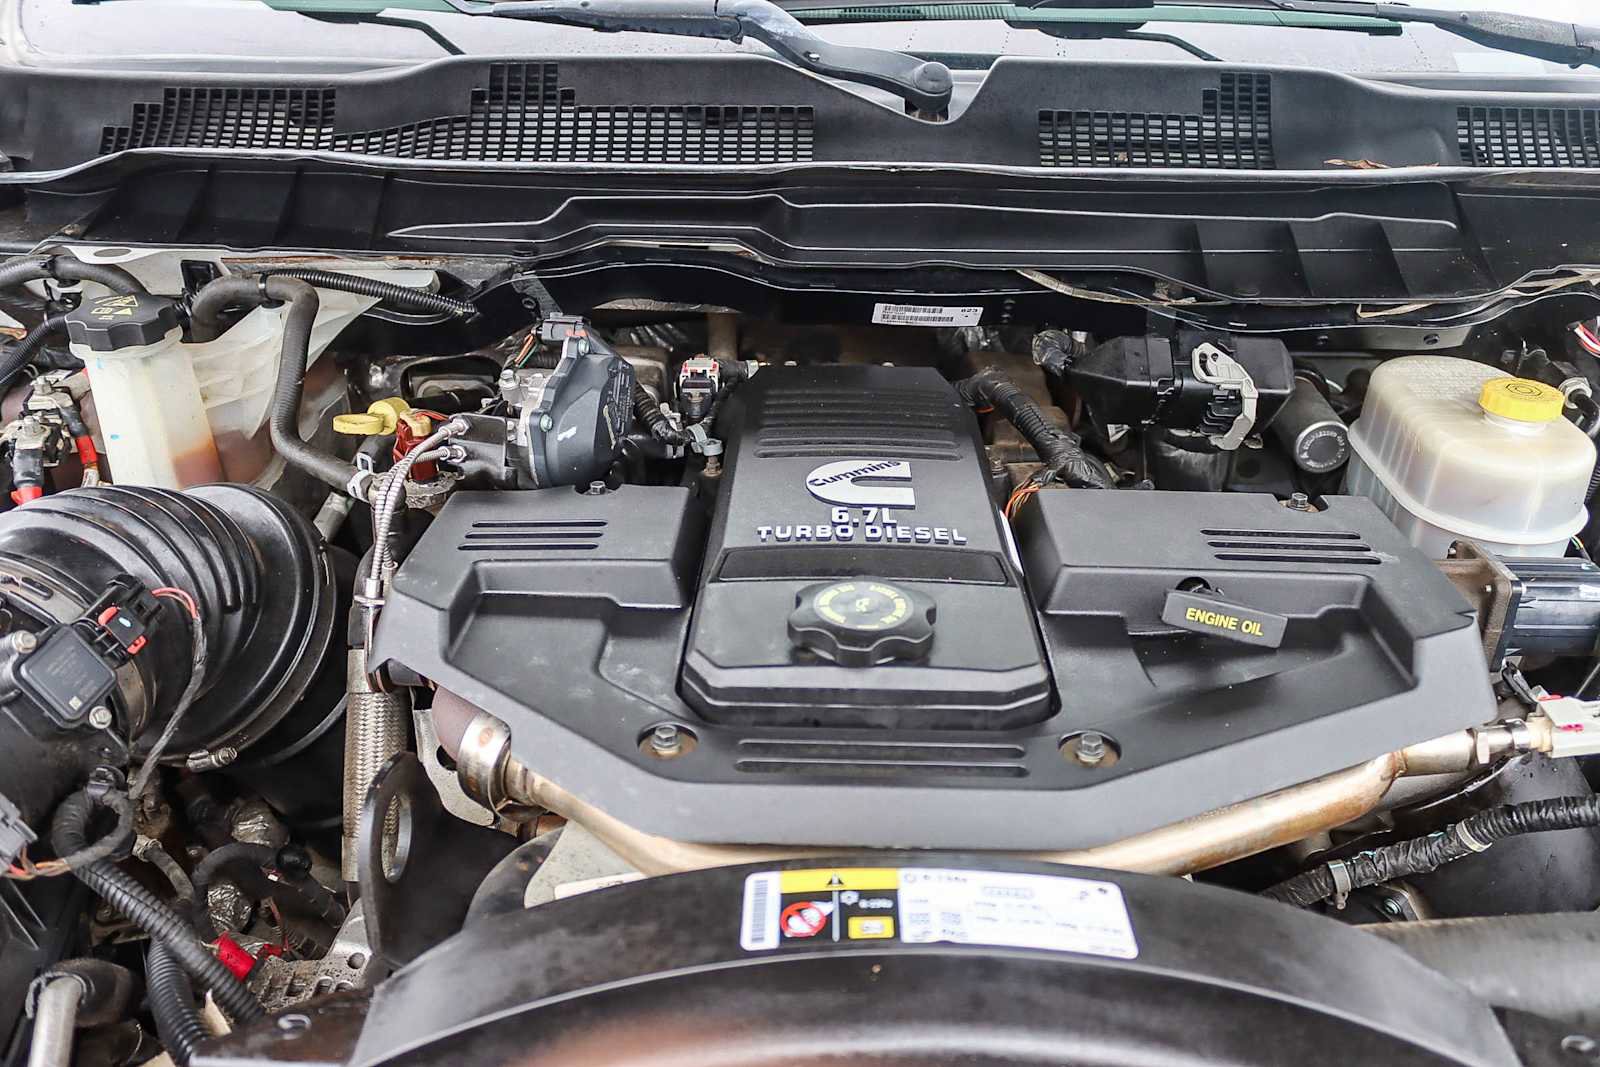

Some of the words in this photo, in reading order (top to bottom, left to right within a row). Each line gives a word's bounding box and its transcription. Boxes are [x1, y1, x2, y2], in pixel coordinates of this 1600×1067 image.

[808, 460, 902, 487] Cummins
[831, 506, 898, 526] 6.7L
[757, 525, 854, 541] TURBO
[865, 525, 968, 544] DIESEL
[1185, 607, 1239, 630] ENGINE
[1241, 620, 1264, 636] OIL
